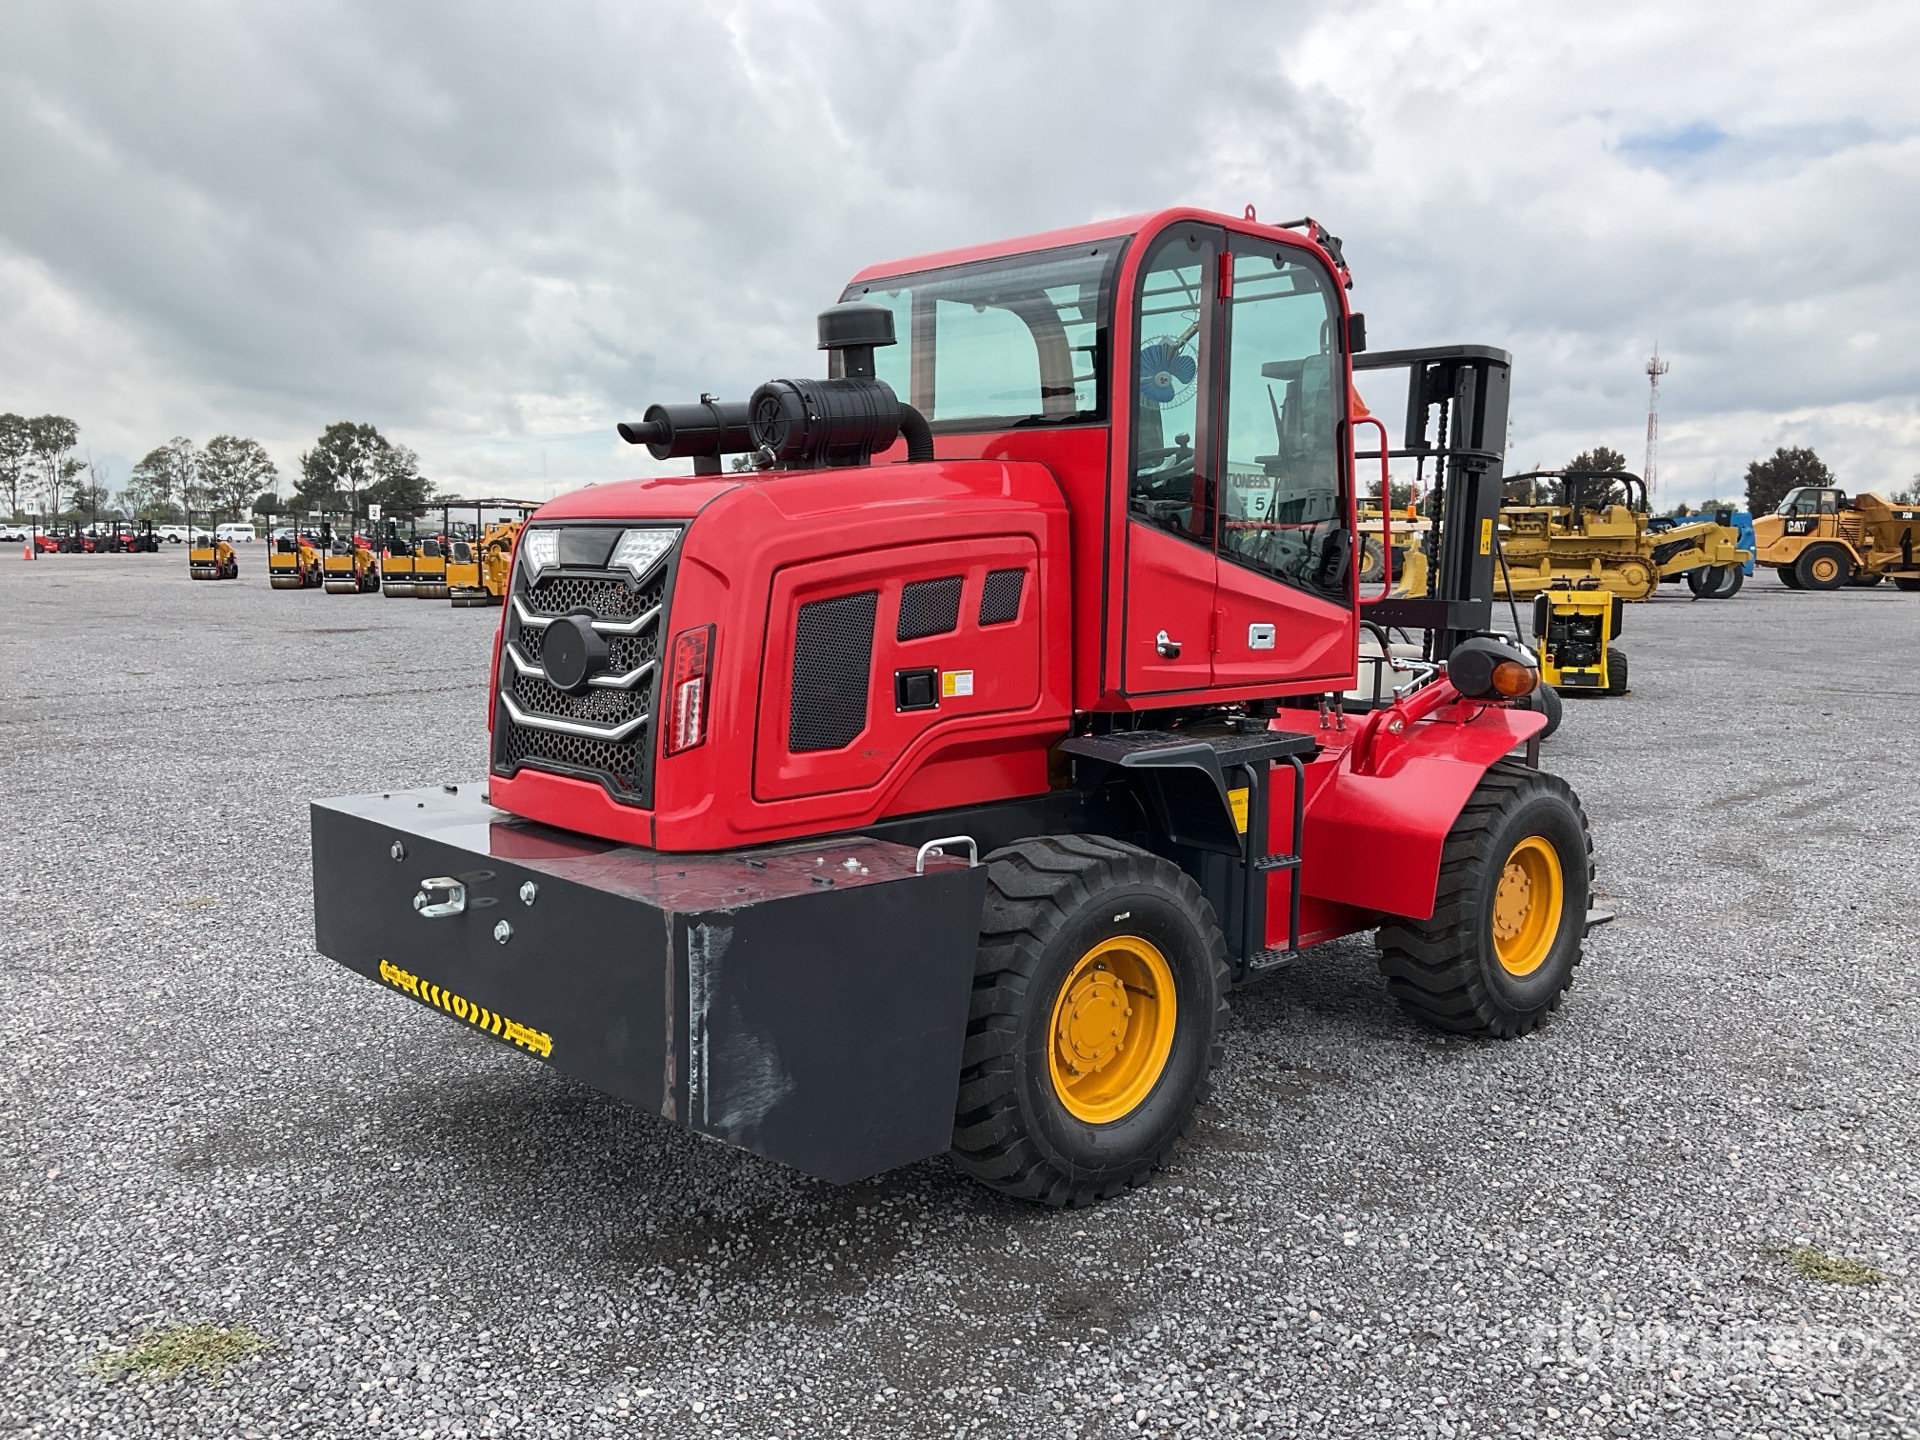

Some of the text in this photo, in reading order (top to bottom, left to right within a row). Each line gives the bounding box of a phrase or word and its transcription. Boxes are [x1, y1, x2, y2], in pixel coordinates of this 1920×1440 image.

[27, 502, 34, 511] 17
[1255, 497, 1265, 511] 5
[371, 509, 377, 517] 2
[1787, 520, 1807, 533] CAT
[384, 966, 412, 984] Keep back
